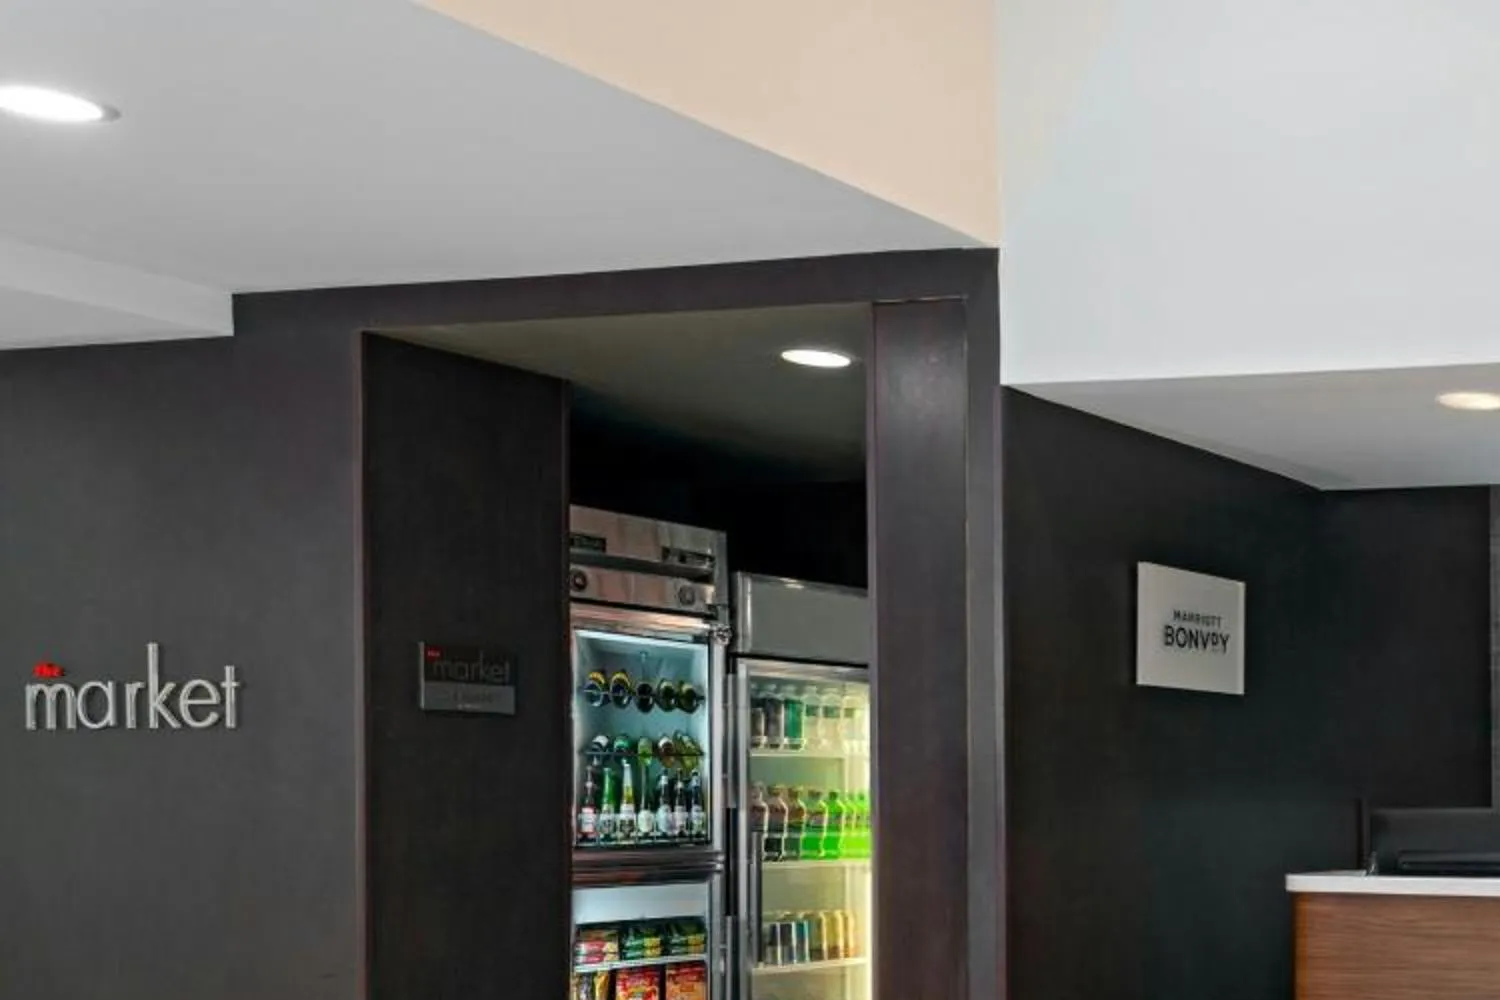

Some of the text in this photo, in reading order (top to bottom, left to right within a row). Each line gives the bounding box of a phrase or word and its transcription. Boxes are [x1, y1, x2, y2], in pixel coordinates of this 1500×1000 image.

[1164, 624, 1230, 653] BONVOY
[432, 650, 510, 684] market
[25, 642, 239, 730] market
